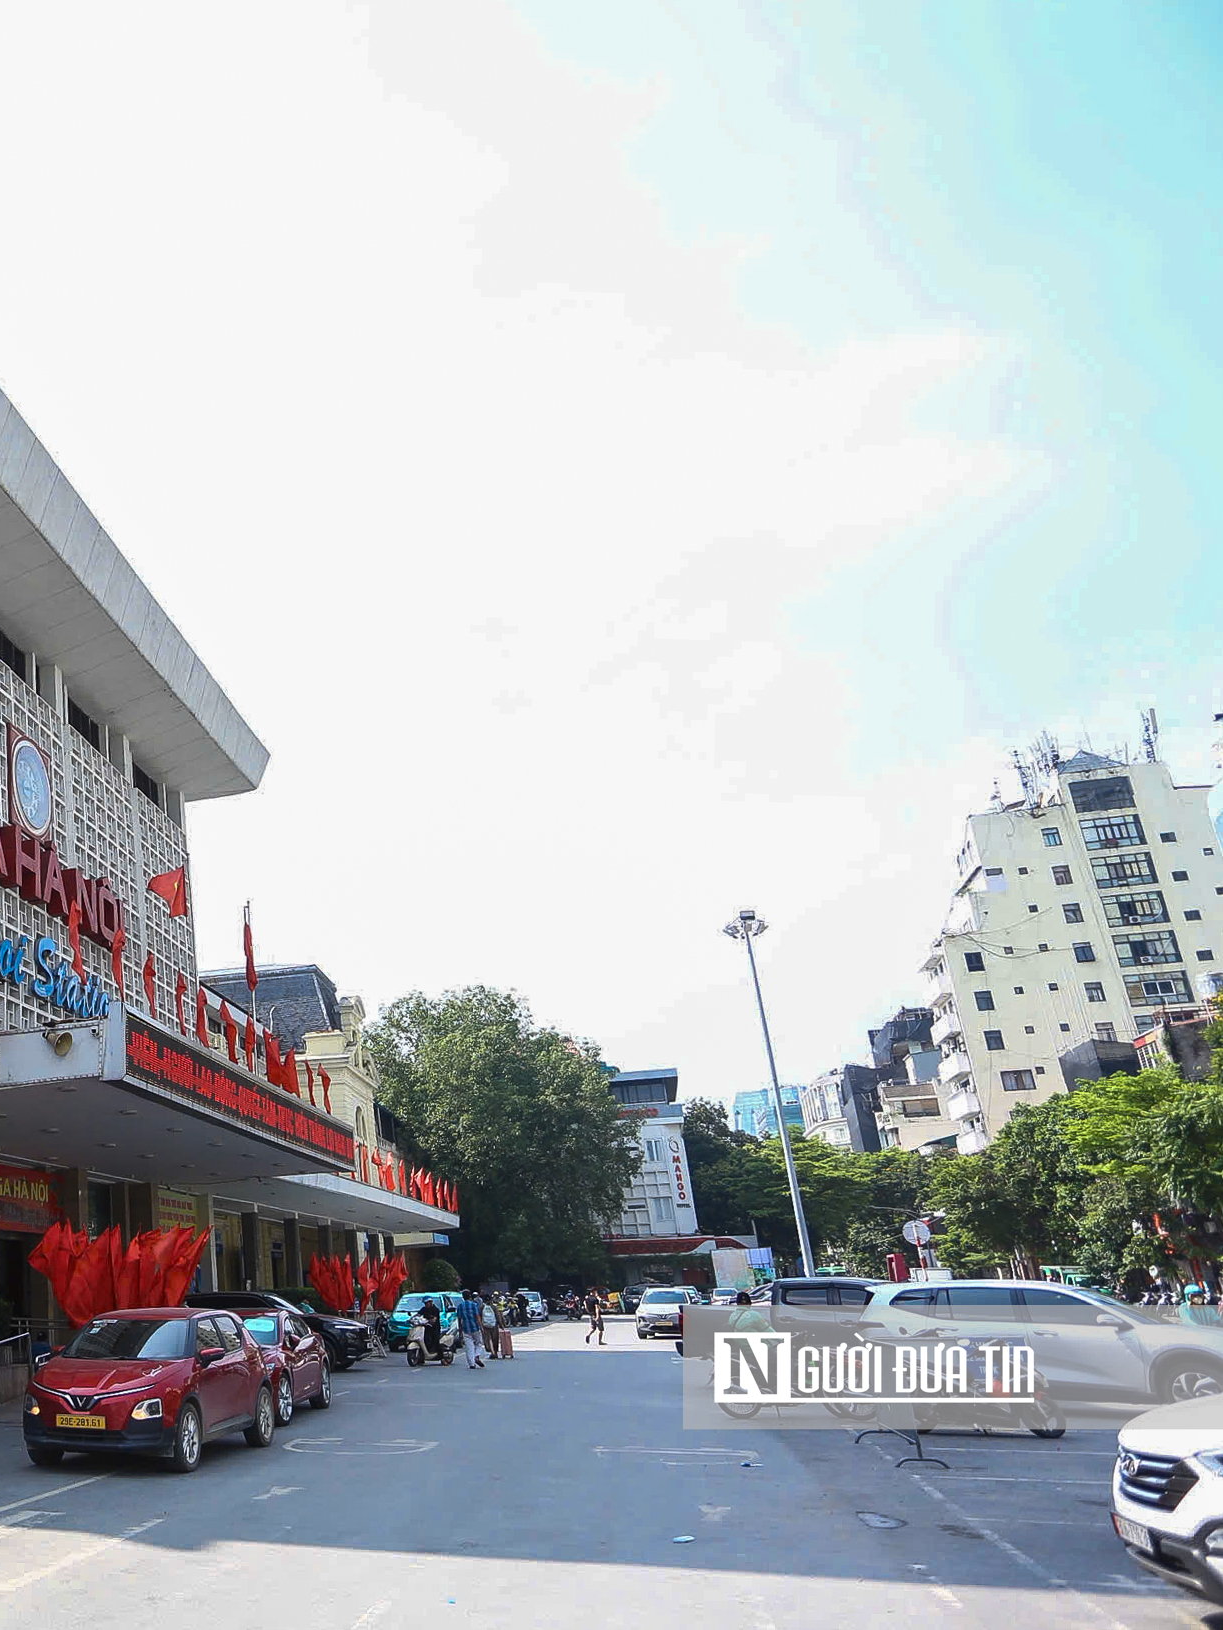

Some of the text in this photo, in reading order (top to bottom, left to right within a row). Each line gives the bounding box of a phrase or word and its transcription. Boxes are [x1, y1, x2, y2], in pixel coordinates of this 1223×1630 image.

[34, 936, 110, 1019] Statio
[13, 1175, 29, 1199] HÀ
[30, 1179, 49, 1207] NỘI
[672, 1155, 686, 1200] MANGO
